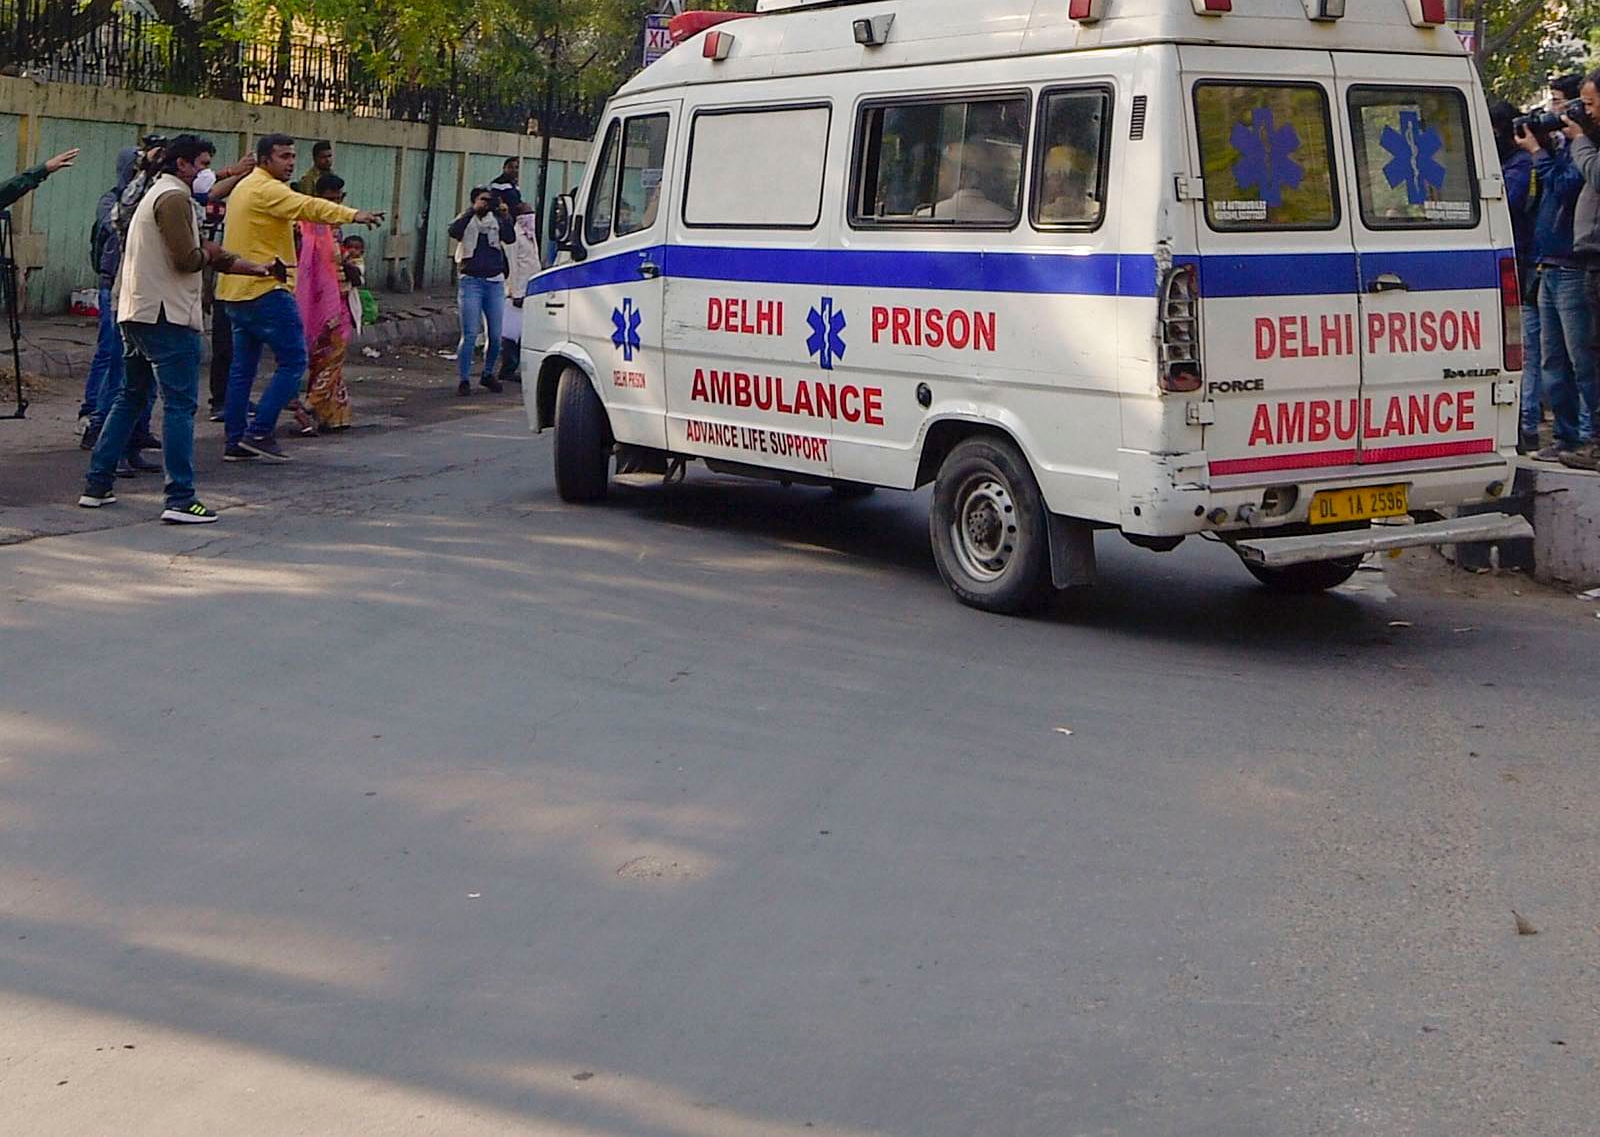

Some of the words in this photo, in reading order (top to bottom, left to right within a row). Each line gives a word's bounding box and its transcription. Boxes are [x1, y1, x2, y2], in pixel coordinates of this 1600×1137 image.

[708, 298, 783, 336] DELHI
[872, 305, 996, 352] PRISON
[1255, 312, 1353, 360] DELHI
[1368, 310, 1481, 354] PRISON
[691, 368, 884, 426] AMBULANCE
[1208, 378, 1264, 394] FORCE
[687, 419, 738, 448] ADVANCE
[740, 427, 768, 453] LIFE
[770, 430, 829, 463] SUPPORT
[1248, 390, 1475, 447] AMBULANCE
[1320, 497, 1338, 518] DL
[1348, 495, 1363, 515] 1A
[1371, 491, 1403, 512] 2596
